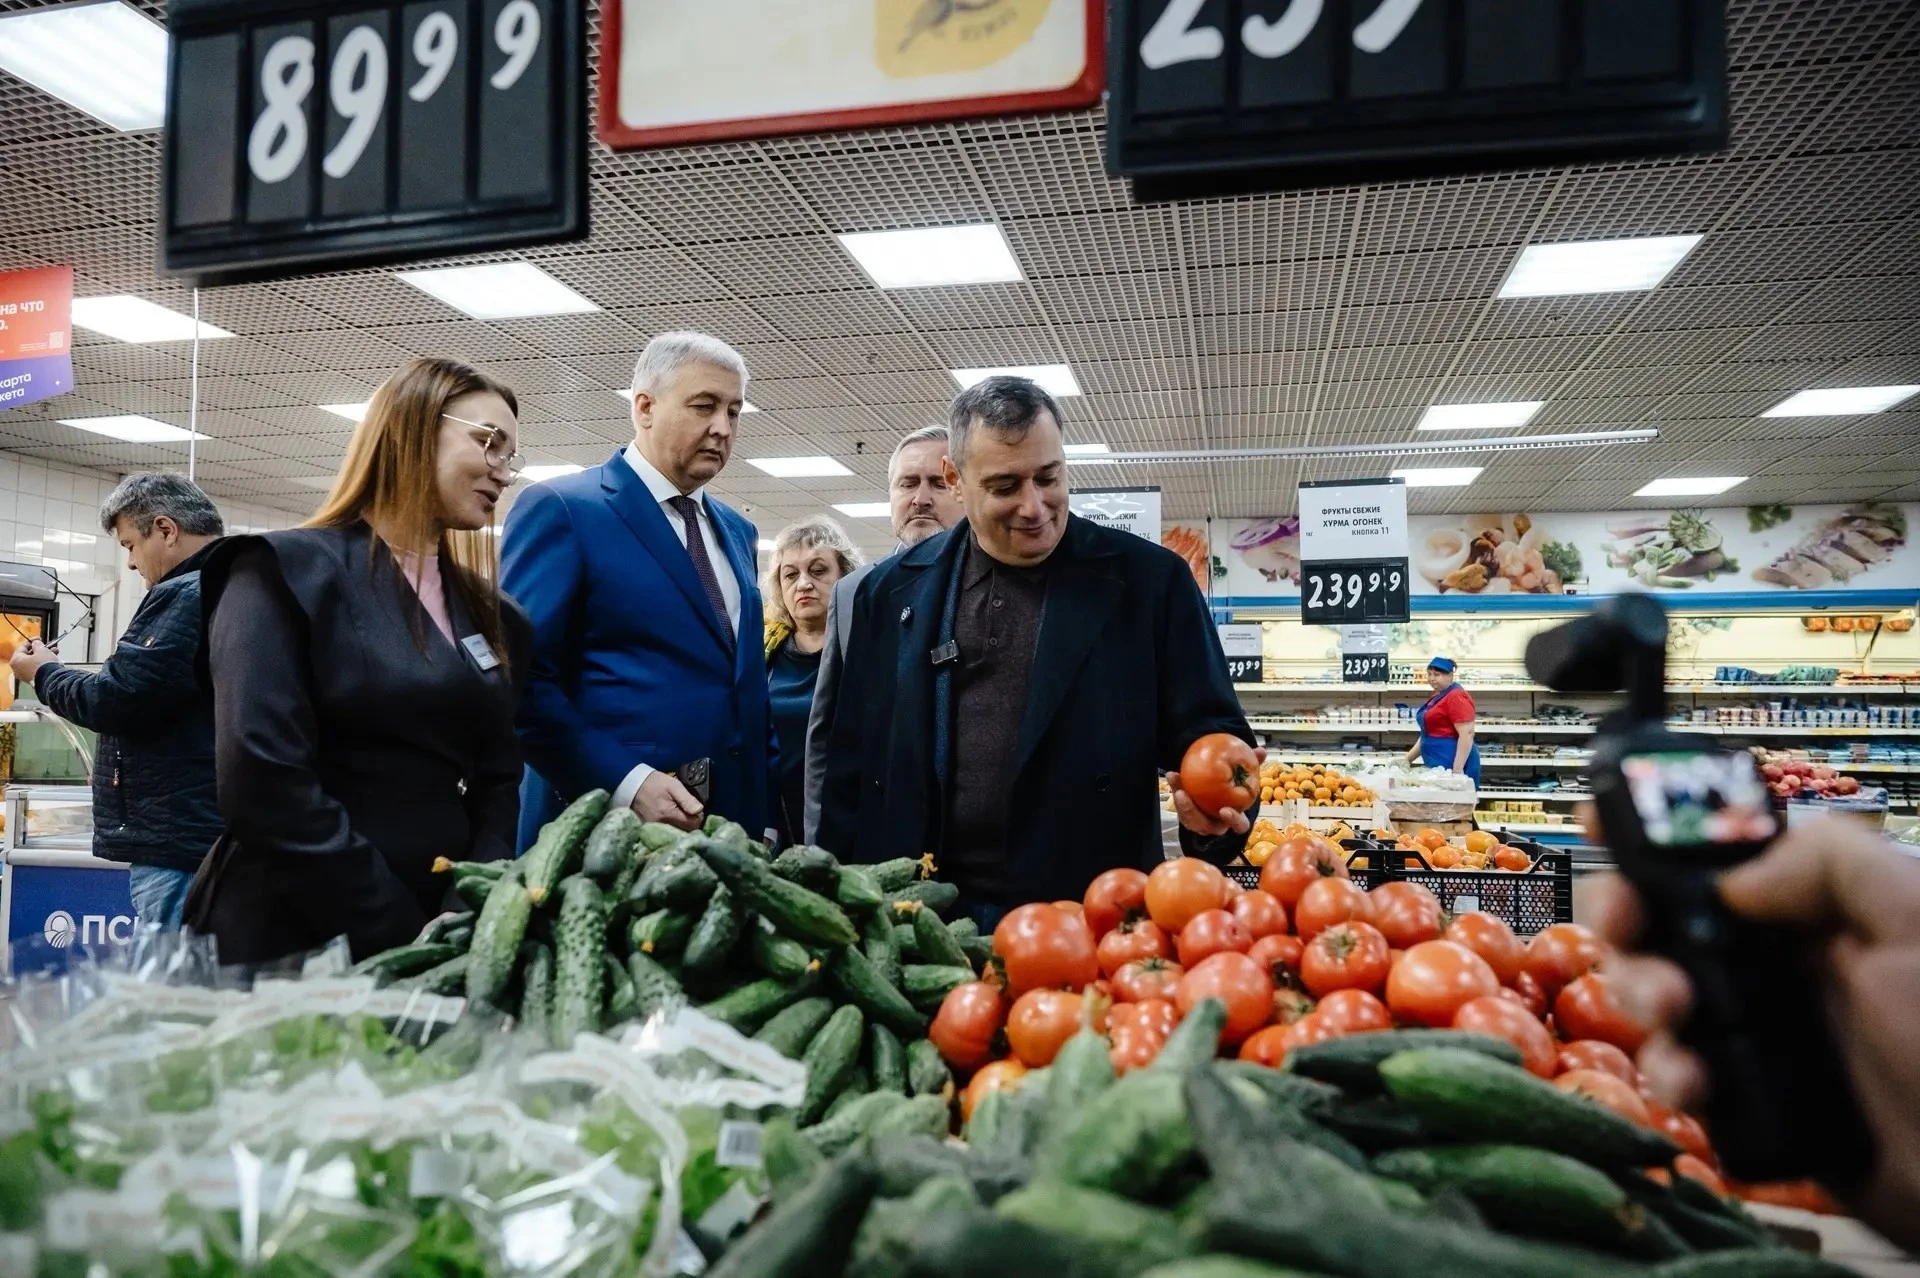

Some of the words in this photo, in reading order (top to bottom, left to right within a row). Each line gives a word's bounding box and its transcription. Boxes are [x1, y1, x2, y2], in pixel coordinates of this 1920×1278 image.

[20, 300, 44, 312] что
[1322, 507, 1351, 515] ФРУКТЫ
[1352, 506, 1381, 514] СВЕЖИЕ
[1323, 519, 1349, 527] ХУРМА
[1352, 518, 1383, 526] ОГОНЕК
[1352, 528, 1379, 536] кнопка
[1381, 526, 1389, 534] 11
[82, 914, 140, 946] ПС
